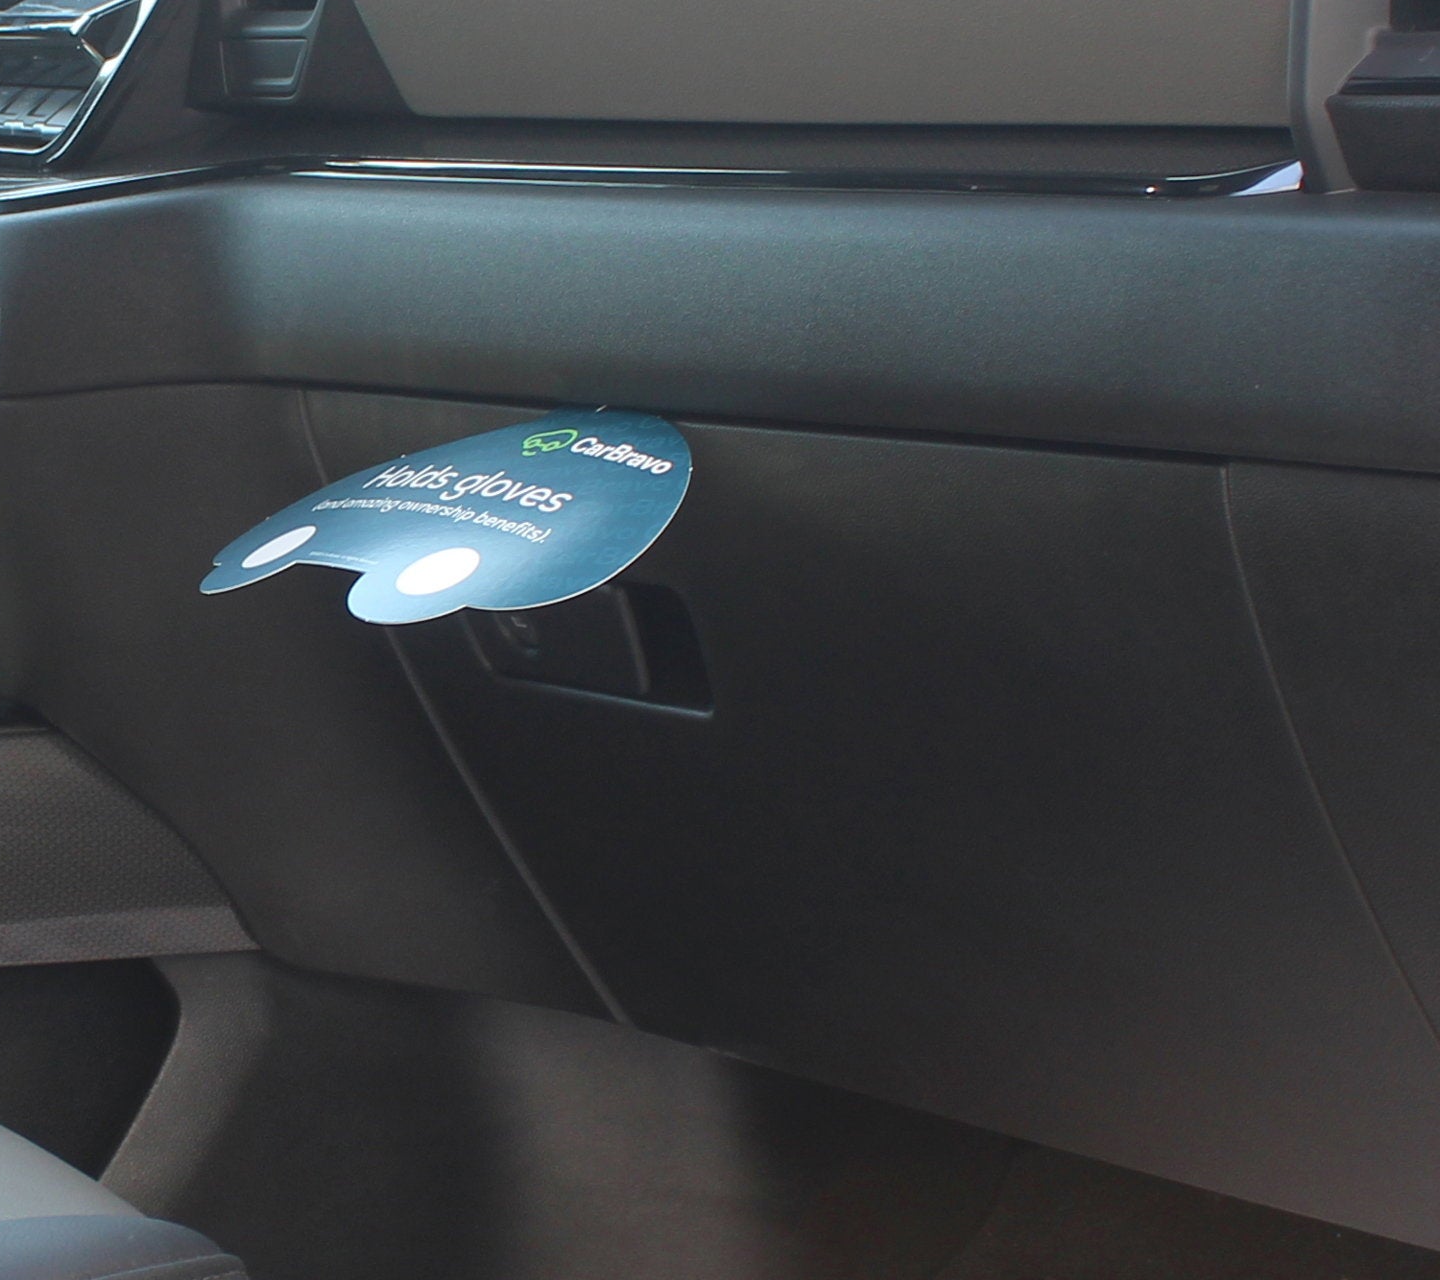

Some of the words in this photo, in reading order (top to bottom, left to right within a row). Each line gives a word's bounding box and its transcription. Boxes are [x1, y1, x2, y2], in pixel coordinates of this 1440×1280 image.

[570, 437, 674, 475] CarBravo
[362, 464, 460, 490] Holds
[438, 471, 574, 513] gloves
[342, 497, 401, 513] amazing
[397, 501, 476, 523] ownership
[472, 512, 553, 544] benefits).
